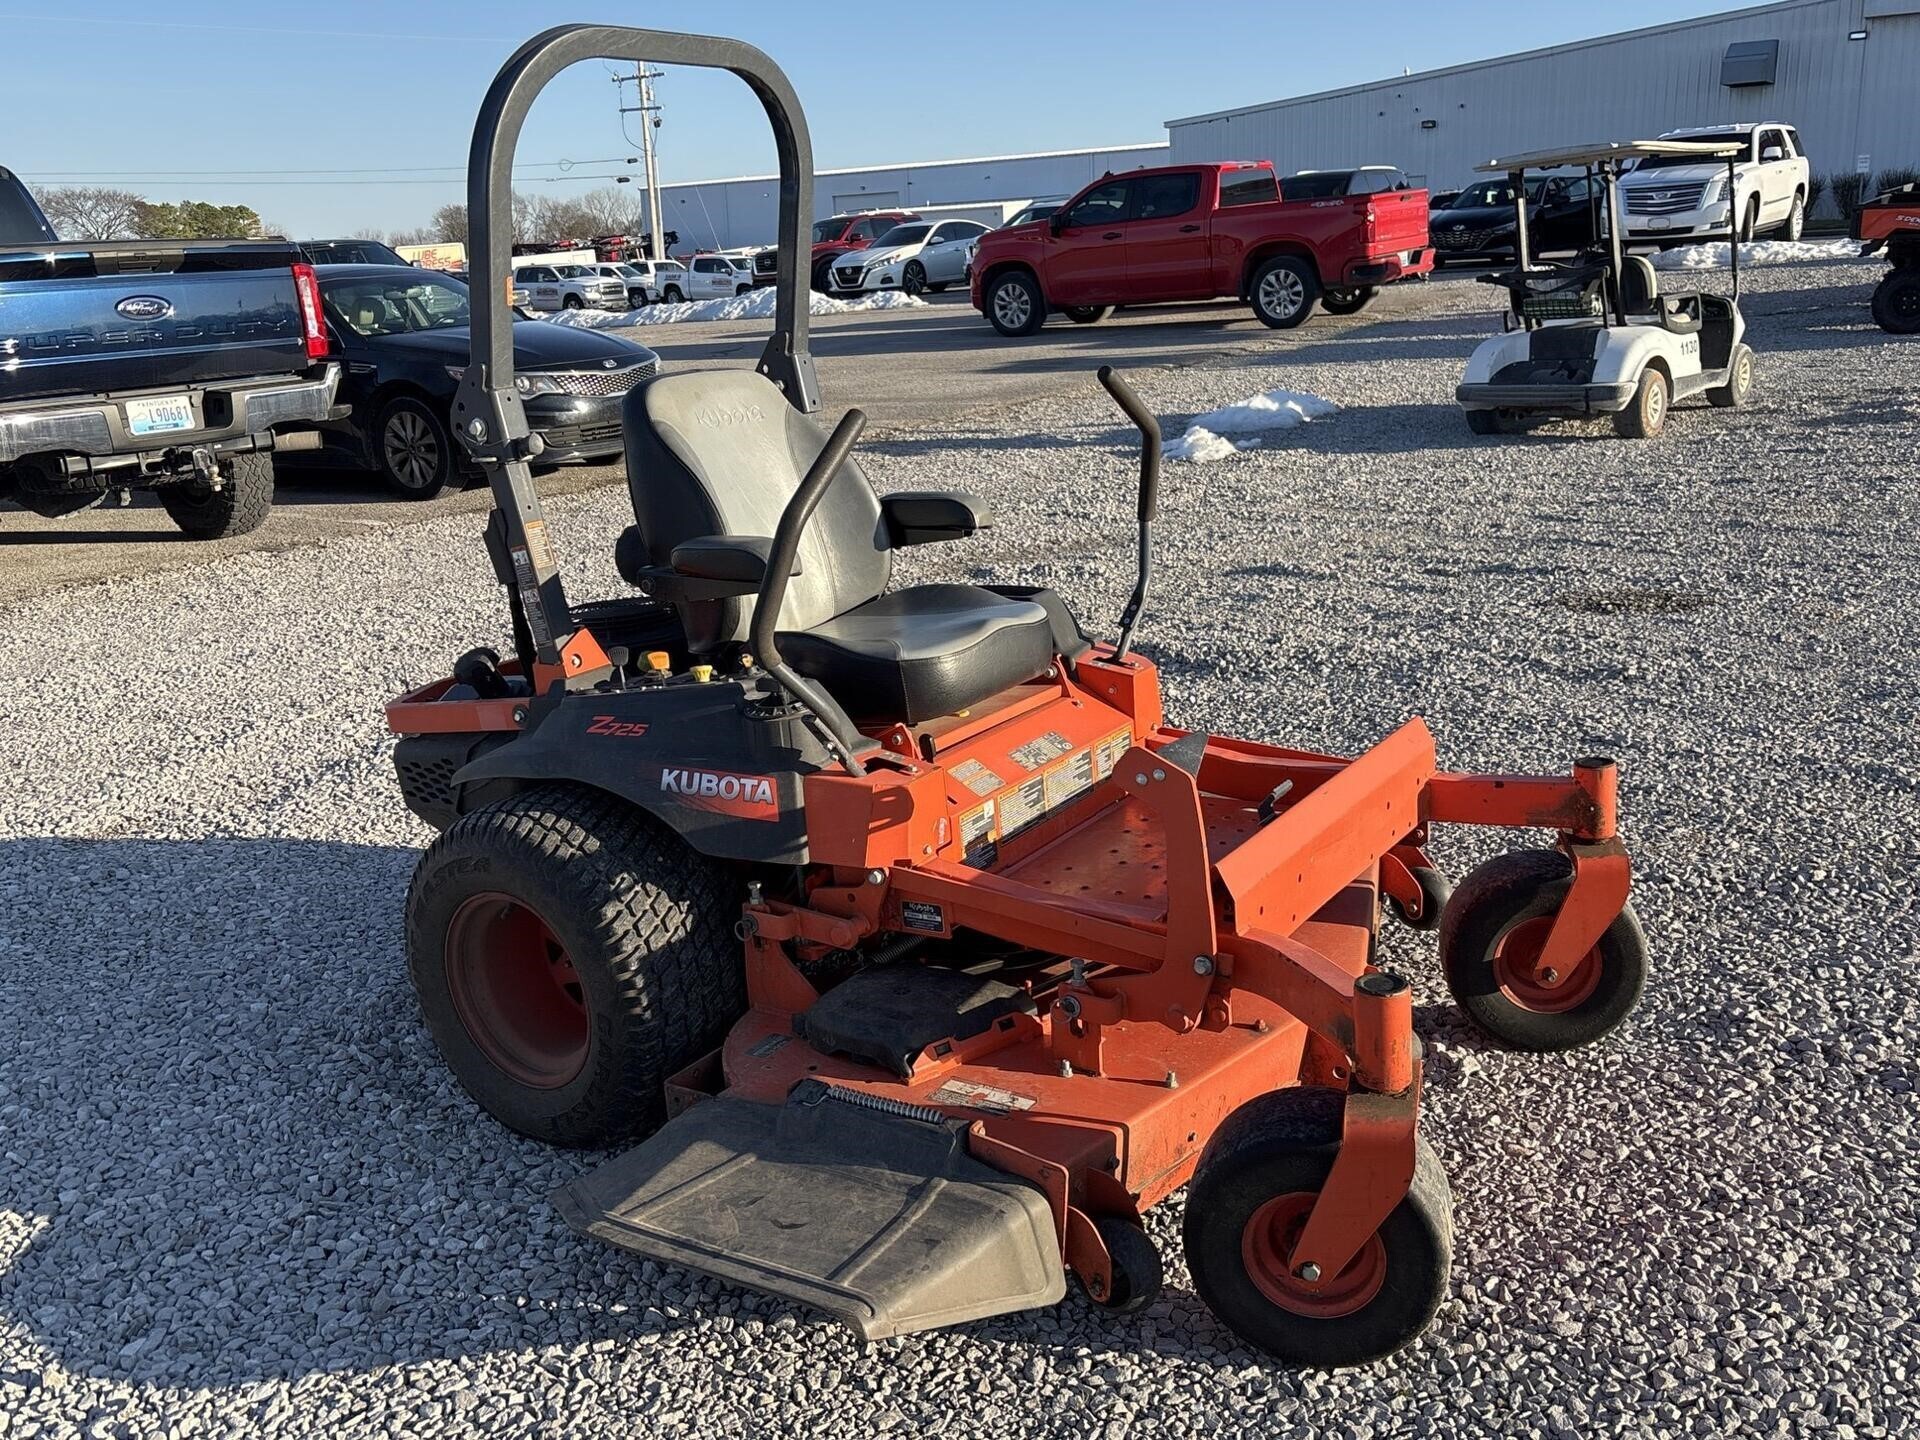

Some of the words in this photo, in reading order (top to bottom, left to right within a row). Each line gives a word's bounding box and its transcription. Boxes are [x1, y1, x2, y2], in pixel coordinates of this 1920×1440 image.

[175, 320, 287, 339] DUTY
[1680, 339, 1698, 356] 1130
[694, 403, 765, 430] Kubota
[586, 715, 649, 737] Z725
[660, 768, 773, 805] KUBOTA
